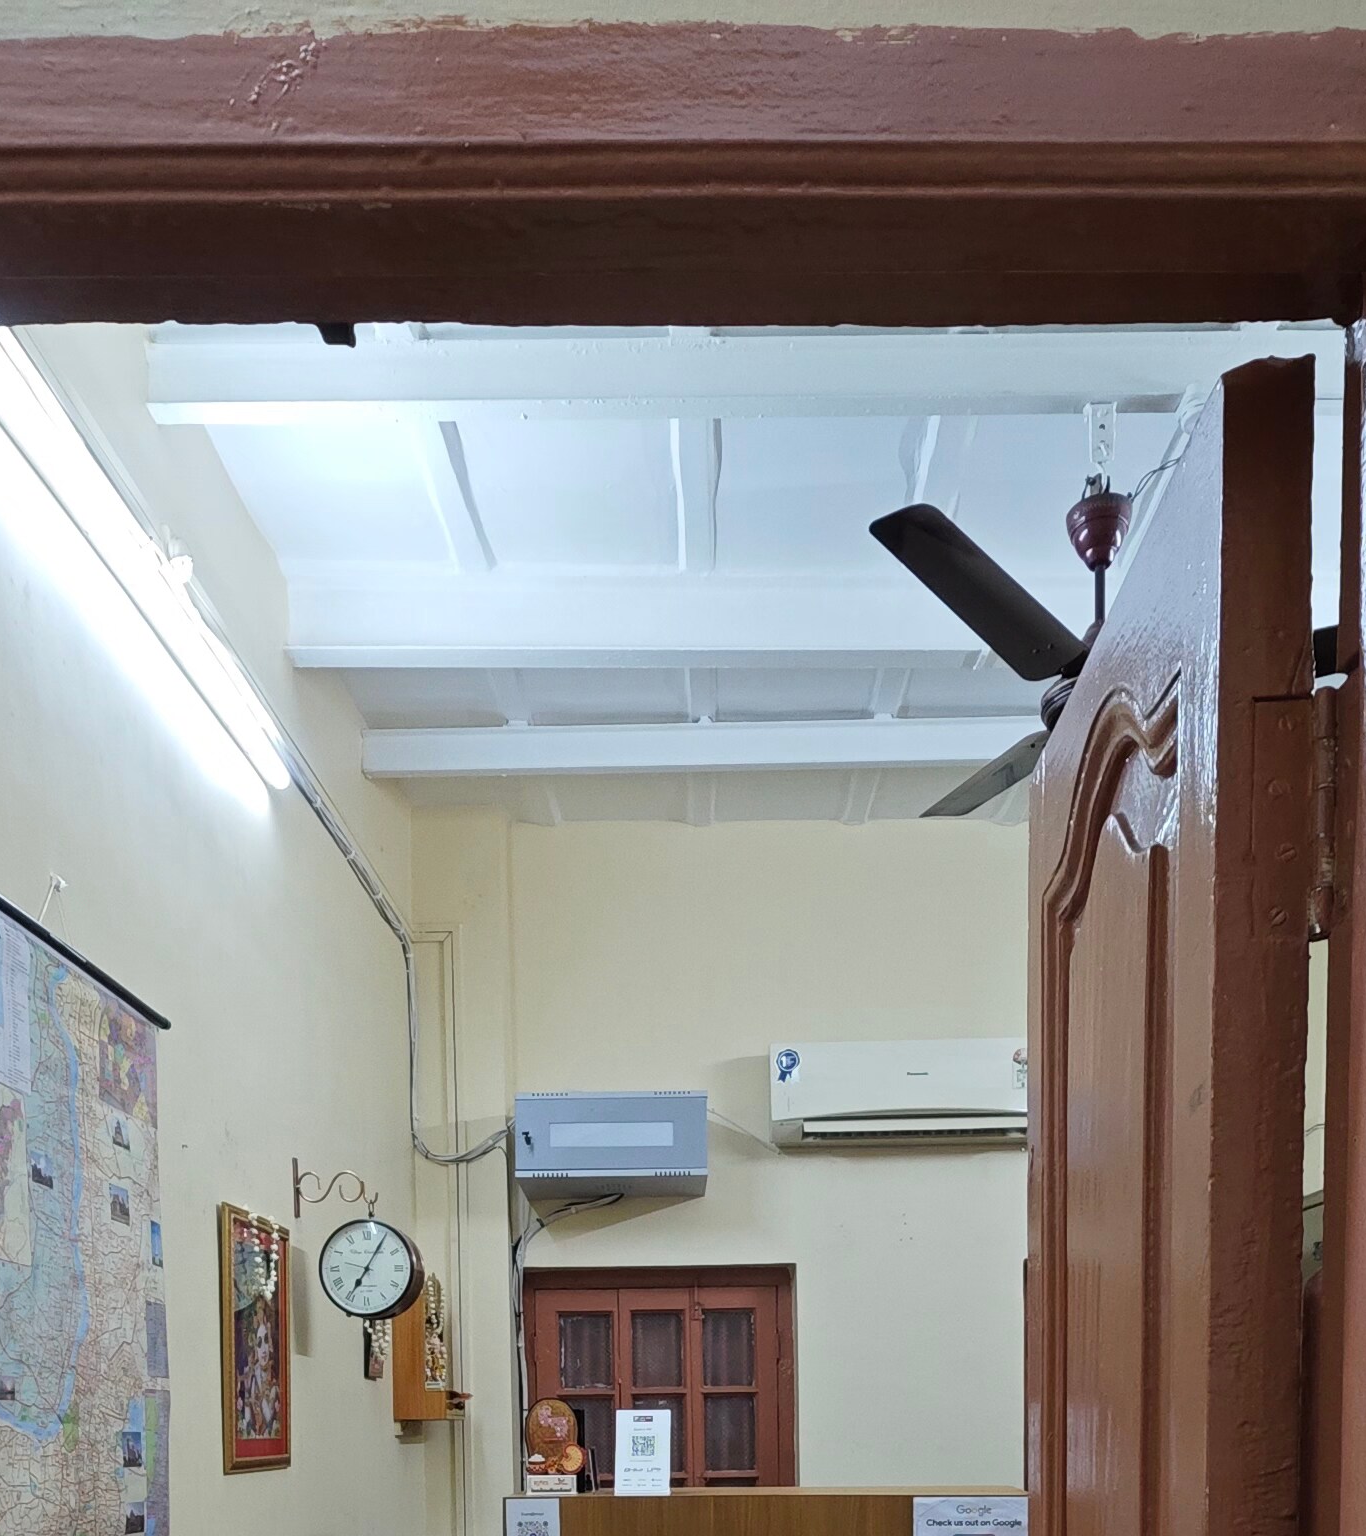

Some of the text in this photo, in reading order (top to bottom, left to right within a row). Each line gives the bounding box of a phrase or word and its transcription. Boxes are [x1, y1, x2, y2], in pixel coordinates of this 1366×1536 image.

[956, 1504, 992, 1517] Google
[926, 1518, 953, 1527] Check
[965, 1519, 979, 1527] out
[992, 1518, 1022, 1529] Google
